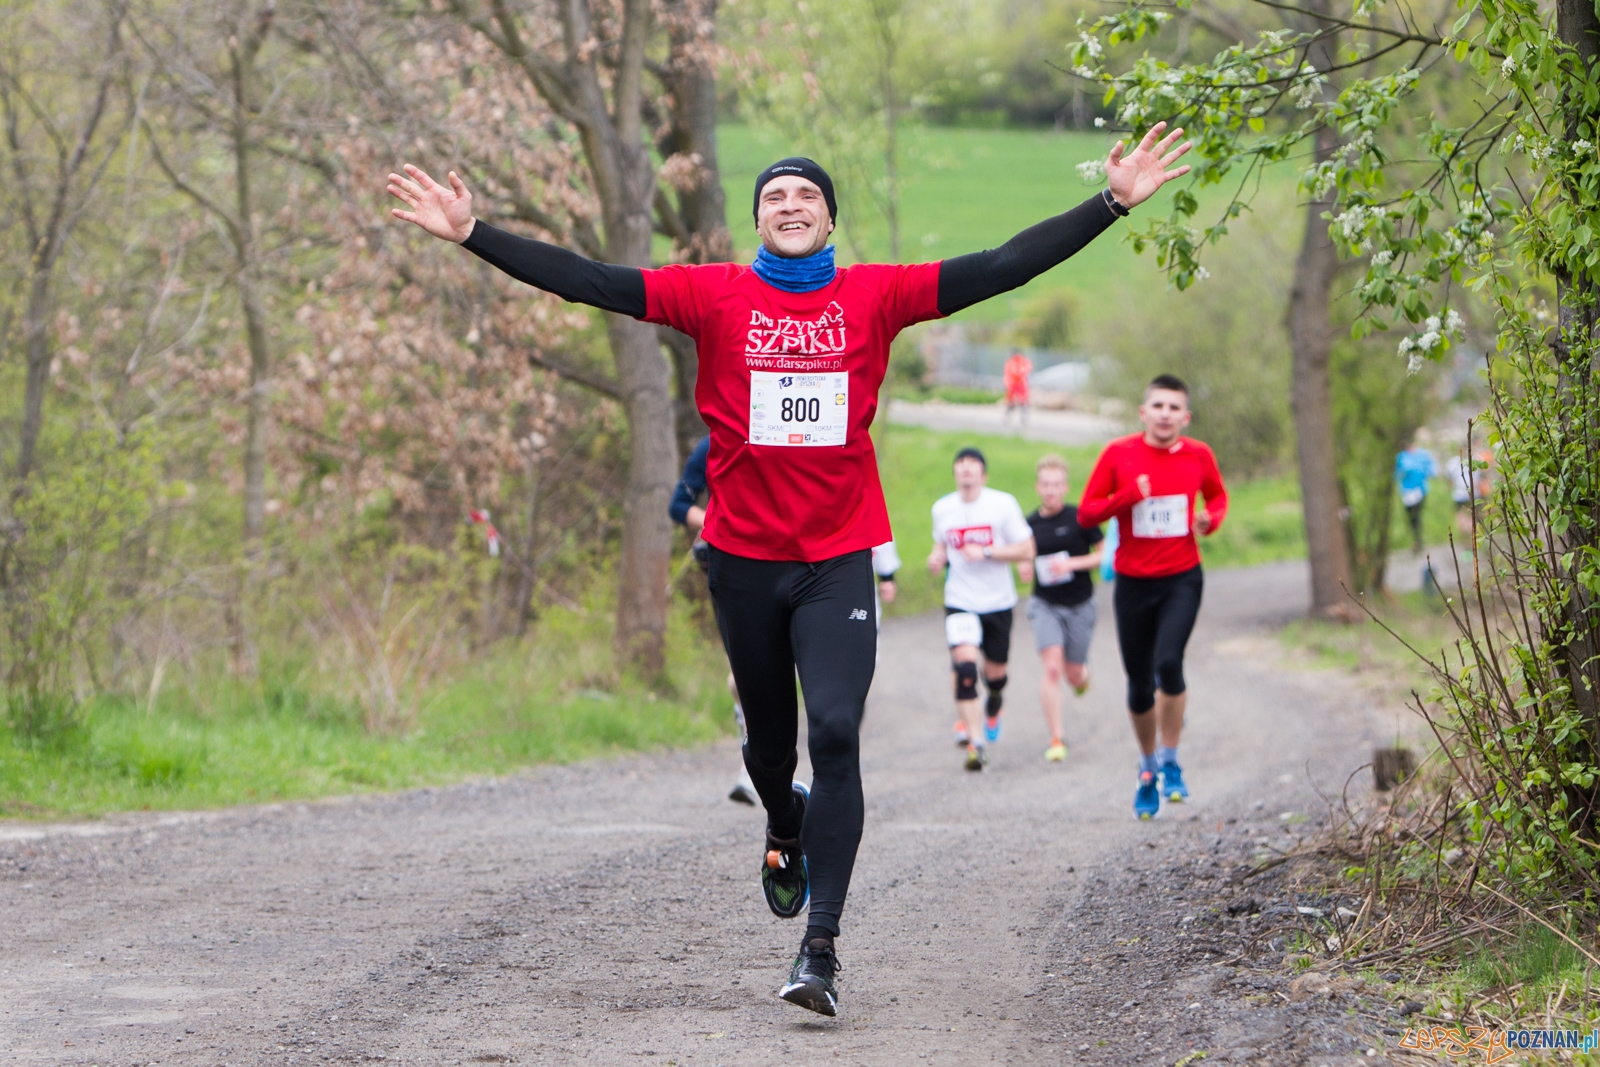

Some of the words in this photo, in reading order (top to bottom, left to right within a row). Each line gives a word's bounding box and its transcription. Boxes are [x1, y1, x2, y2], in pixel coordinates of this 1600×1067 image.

[745, 327, 846, 354] SZPIKU
[745, 357, 842, 371] www.darszpiku.pl
[781, 397, 820, 422] 800
